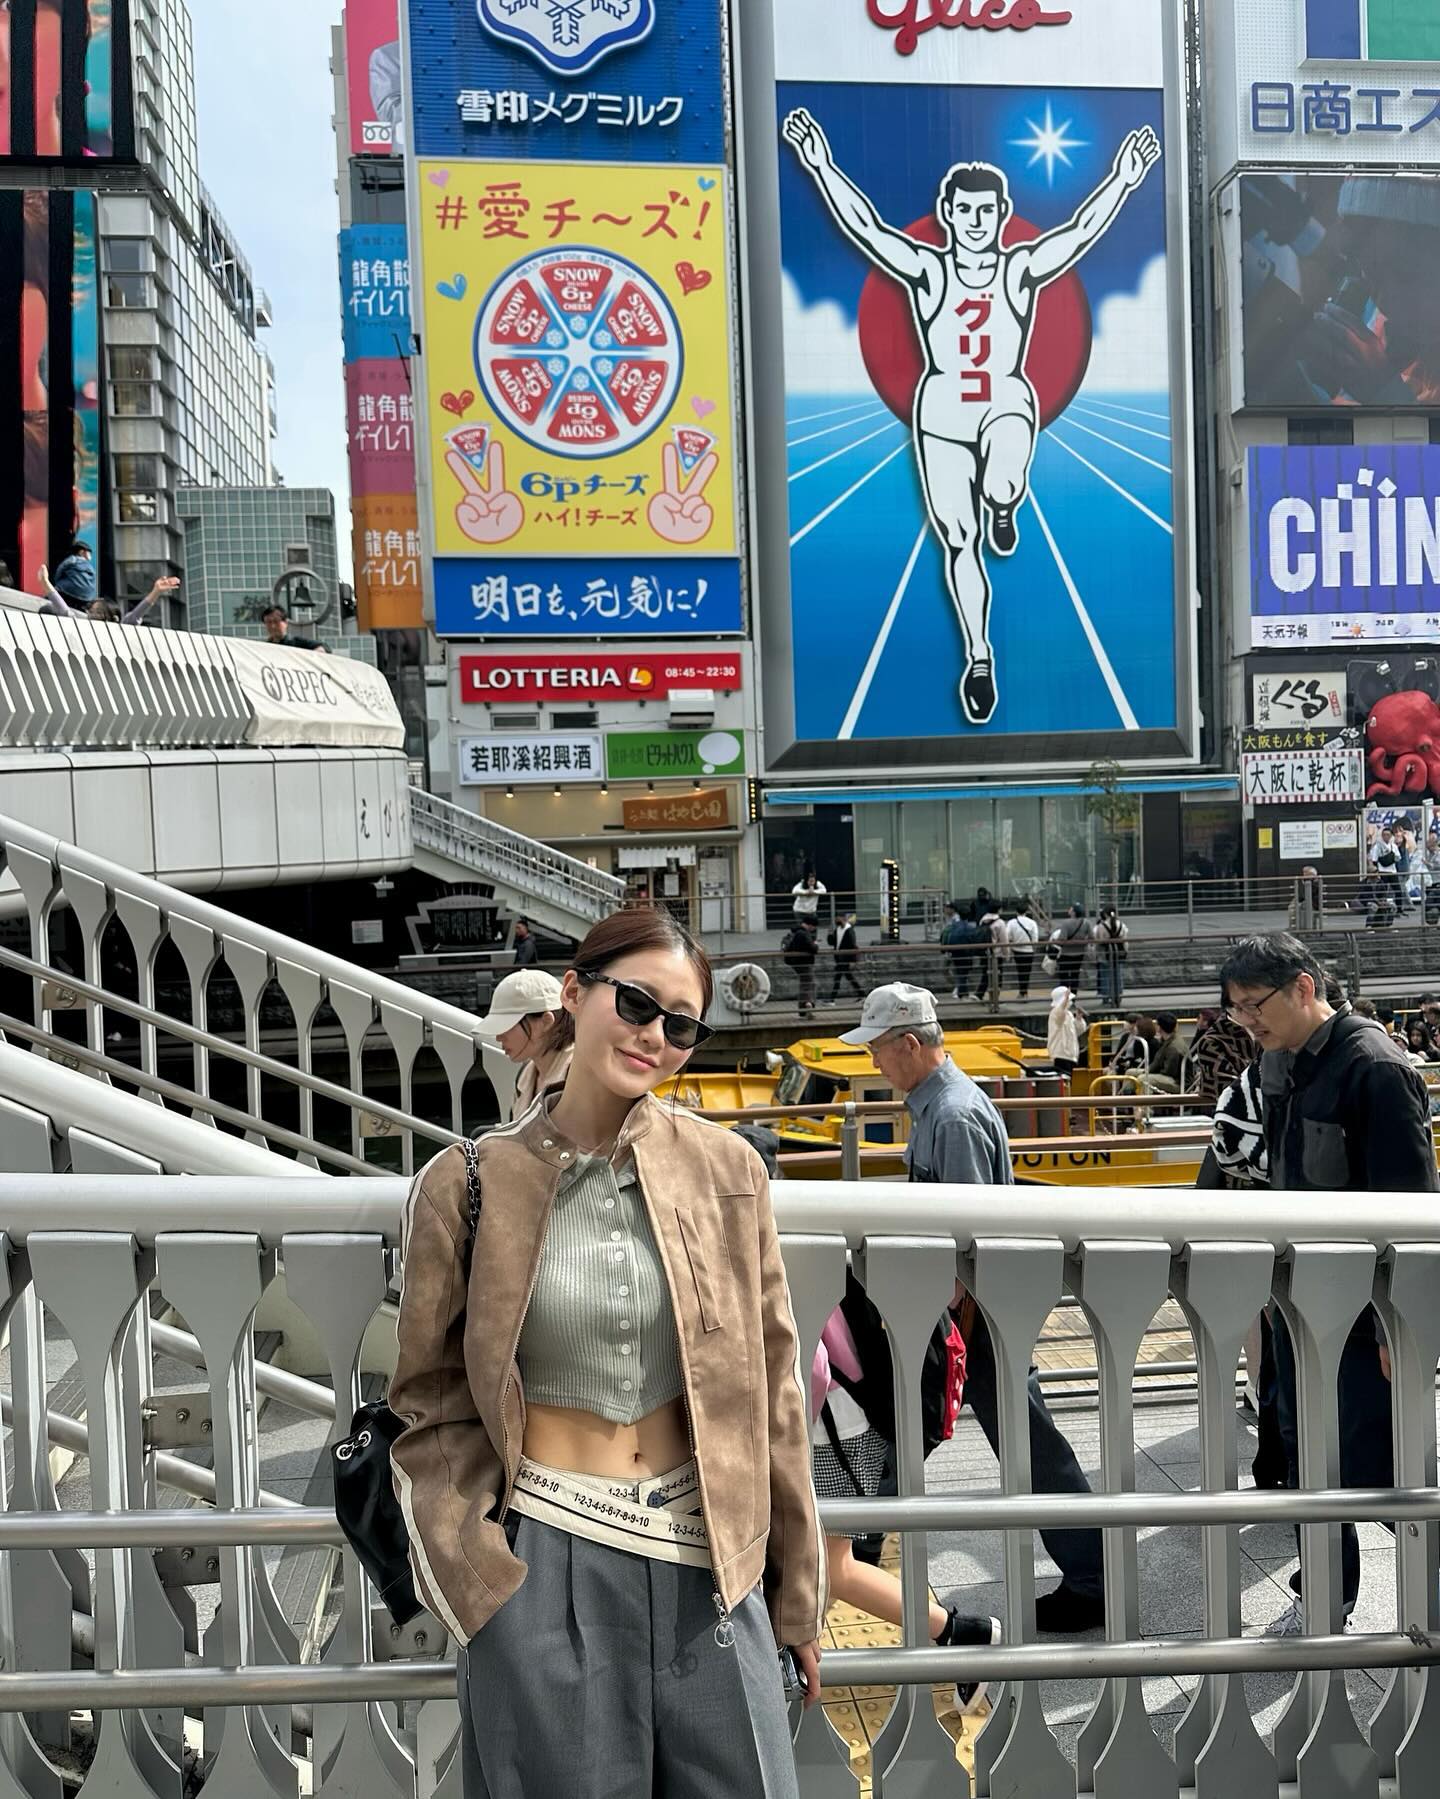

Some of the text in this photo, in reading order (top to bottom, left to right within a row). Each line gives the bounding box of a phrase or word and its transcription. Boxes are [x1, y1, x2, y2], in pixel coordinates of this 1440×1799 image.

[456, 90, 683, 126] 雪印メグミルク
[1251, 80, 1440, 135] 日商エス
[552, 267, 601, 282] SNOW
[954, 293, 994, 403] グリコ
[558, 424, 607, 438] SNOW
[1262, 624, 1308, 639] 天気予報
[473, 667, 621, 689] LOTTERIA
[1250, 760, 1346, 794] 大阪に乾杯
